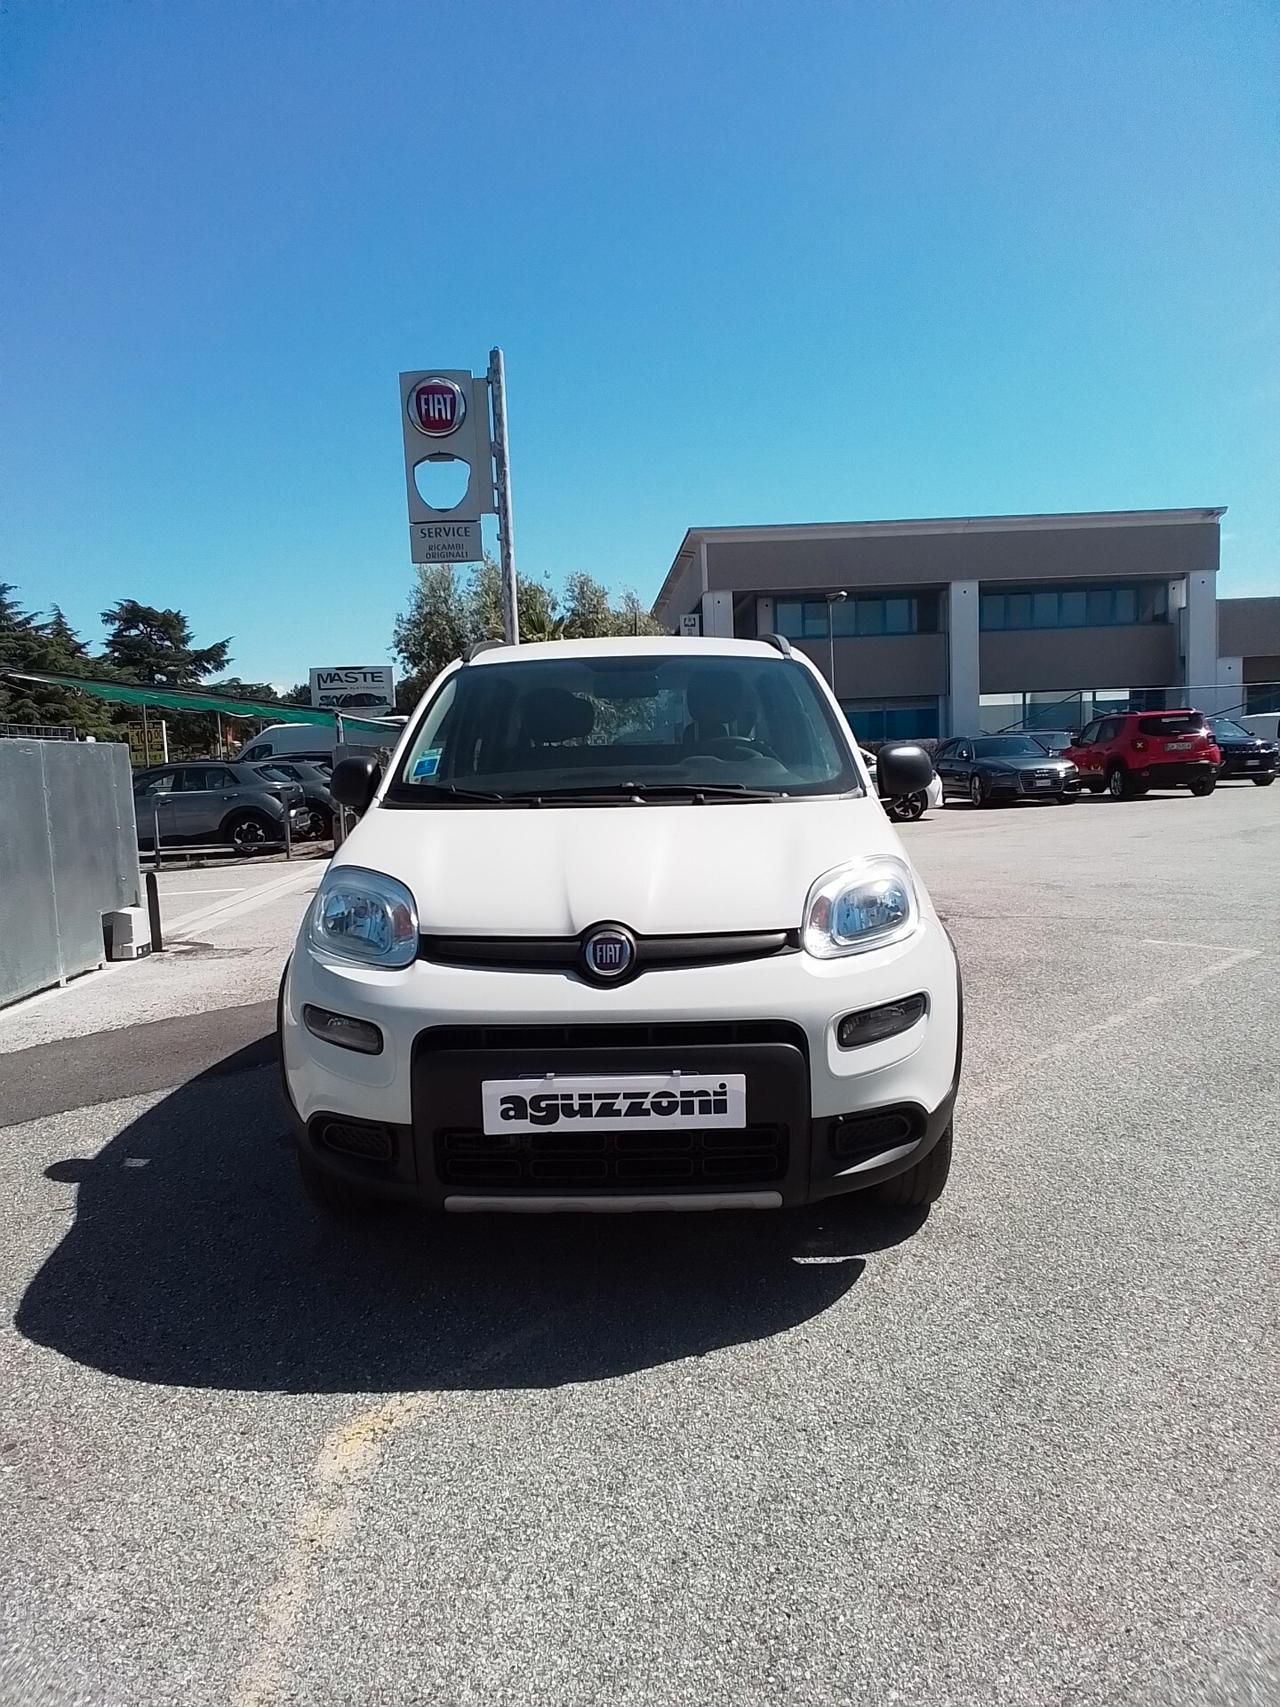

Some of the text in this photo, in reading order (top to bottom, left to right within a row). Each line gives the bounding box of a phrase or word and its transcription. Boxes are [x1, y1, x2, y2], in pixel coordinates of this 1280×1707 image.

[420, 394, 453, 420] FIAT
[420, 526, 471, 538] SERVICE
[428, 543, 464, 551] RICAMBI
[425, 551, 468, 560] ORIGINALI
[596, 944, 621, 964] FIAT
[499, 1082, 728, 1126] aguzzoni
